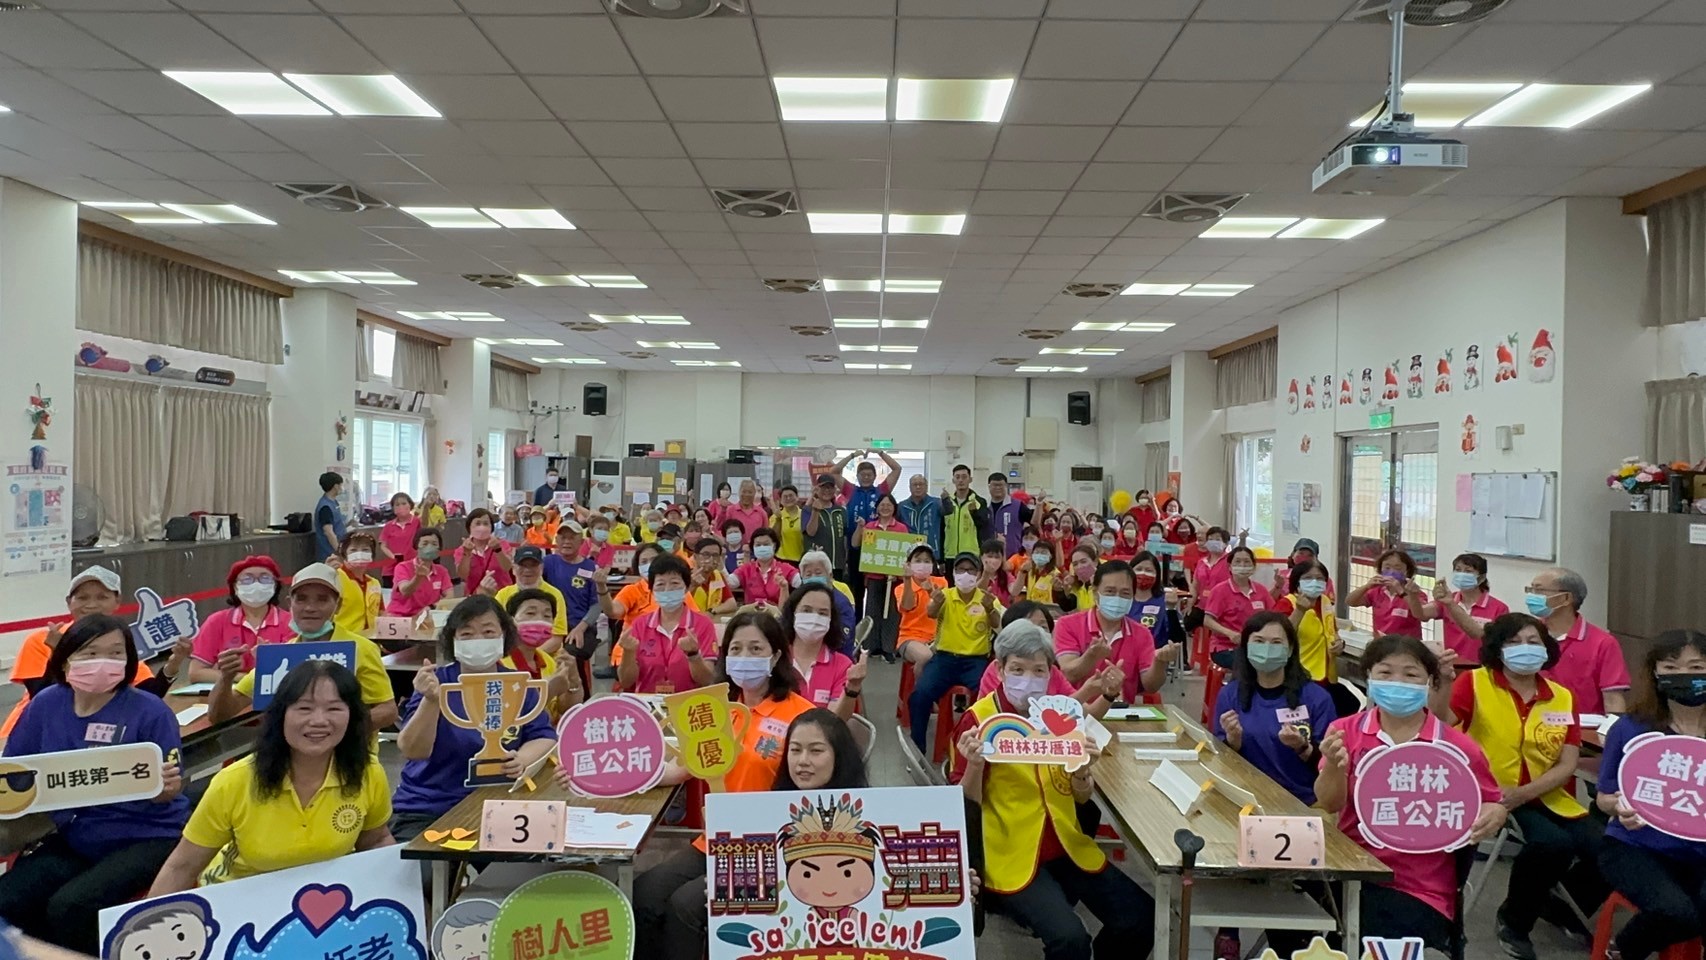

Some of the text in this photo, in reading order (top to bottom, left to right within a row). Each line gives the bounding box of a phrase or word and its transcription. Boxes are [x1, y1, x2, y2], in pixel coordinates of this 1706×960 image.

[145, 612, 182, 645] 讚
[389, 622, 398, 637] 5
[484, 680, 503, 731] 我最棒
[583, 714, 637, 744] 樹林
[686, 702, 726, 769] 績優
[46, 762, 151, 790] 叫我第一名
[571, 745, 653, 777] 區公所
[1387, 762, 1450, 793] 樹林
[511, 814, 530, 844] 3
[1371, 797, 1466, 830] 區公所
[1274, 833, 1292, 861] 2
[512, 907, 613, 960] 樹人里
